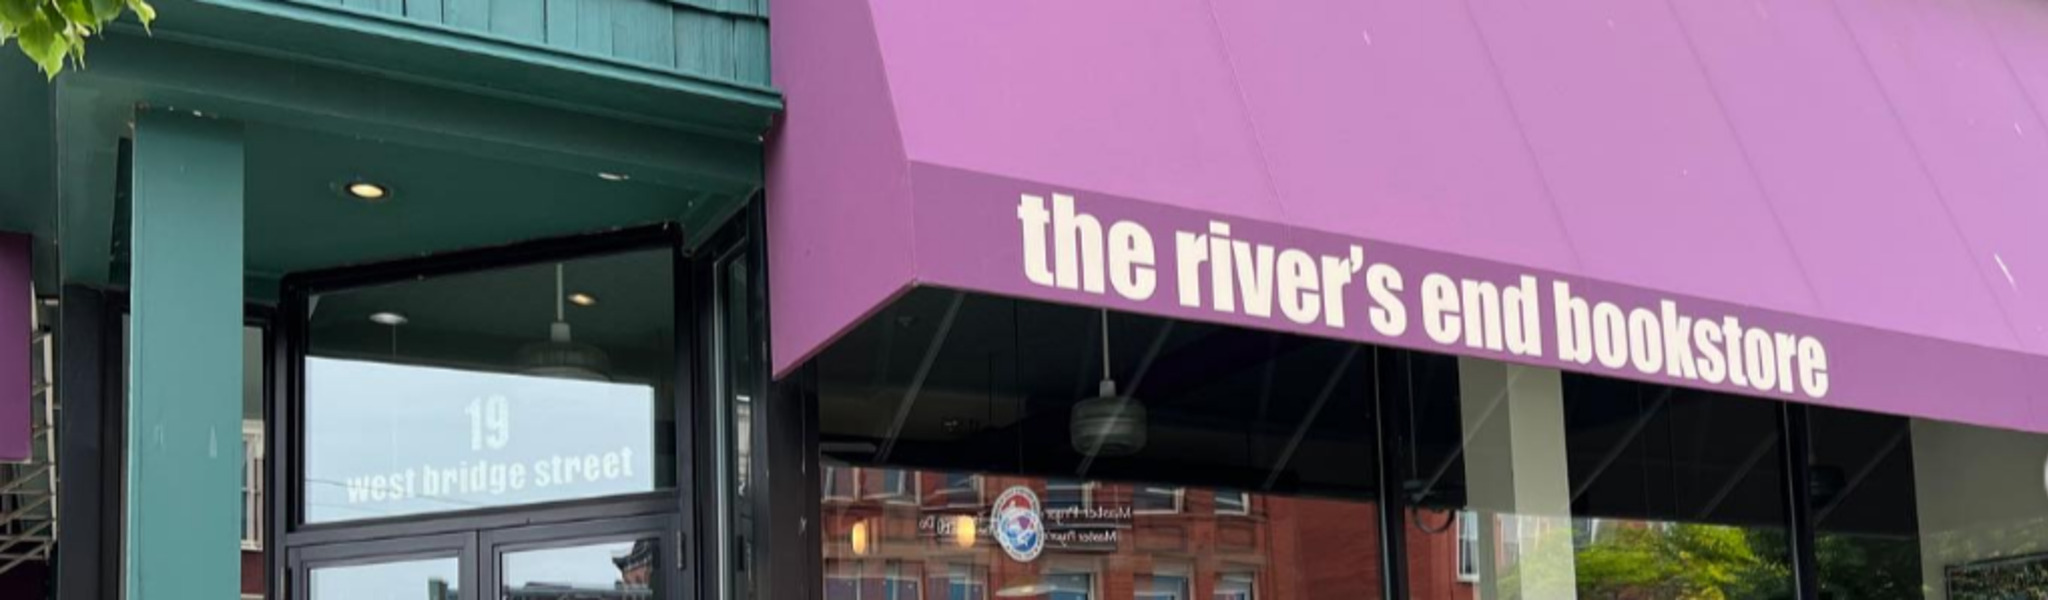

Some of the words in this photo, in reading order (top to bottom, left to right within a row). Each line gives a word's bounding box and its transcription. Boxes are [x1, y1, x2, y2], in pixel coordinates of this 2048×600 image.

[1017, 193, 1157, 301] the
[1175, 220, 1408, 337] river’s
[1421, 272, 1542, 358] end
[1553, 280, 1829, 399] bookstore
[465, 394, 510, 451] 19
[346, 467, 415, 502] west
[422, 460, 527, 495] bridge
[534, 446, 634, 487] street
